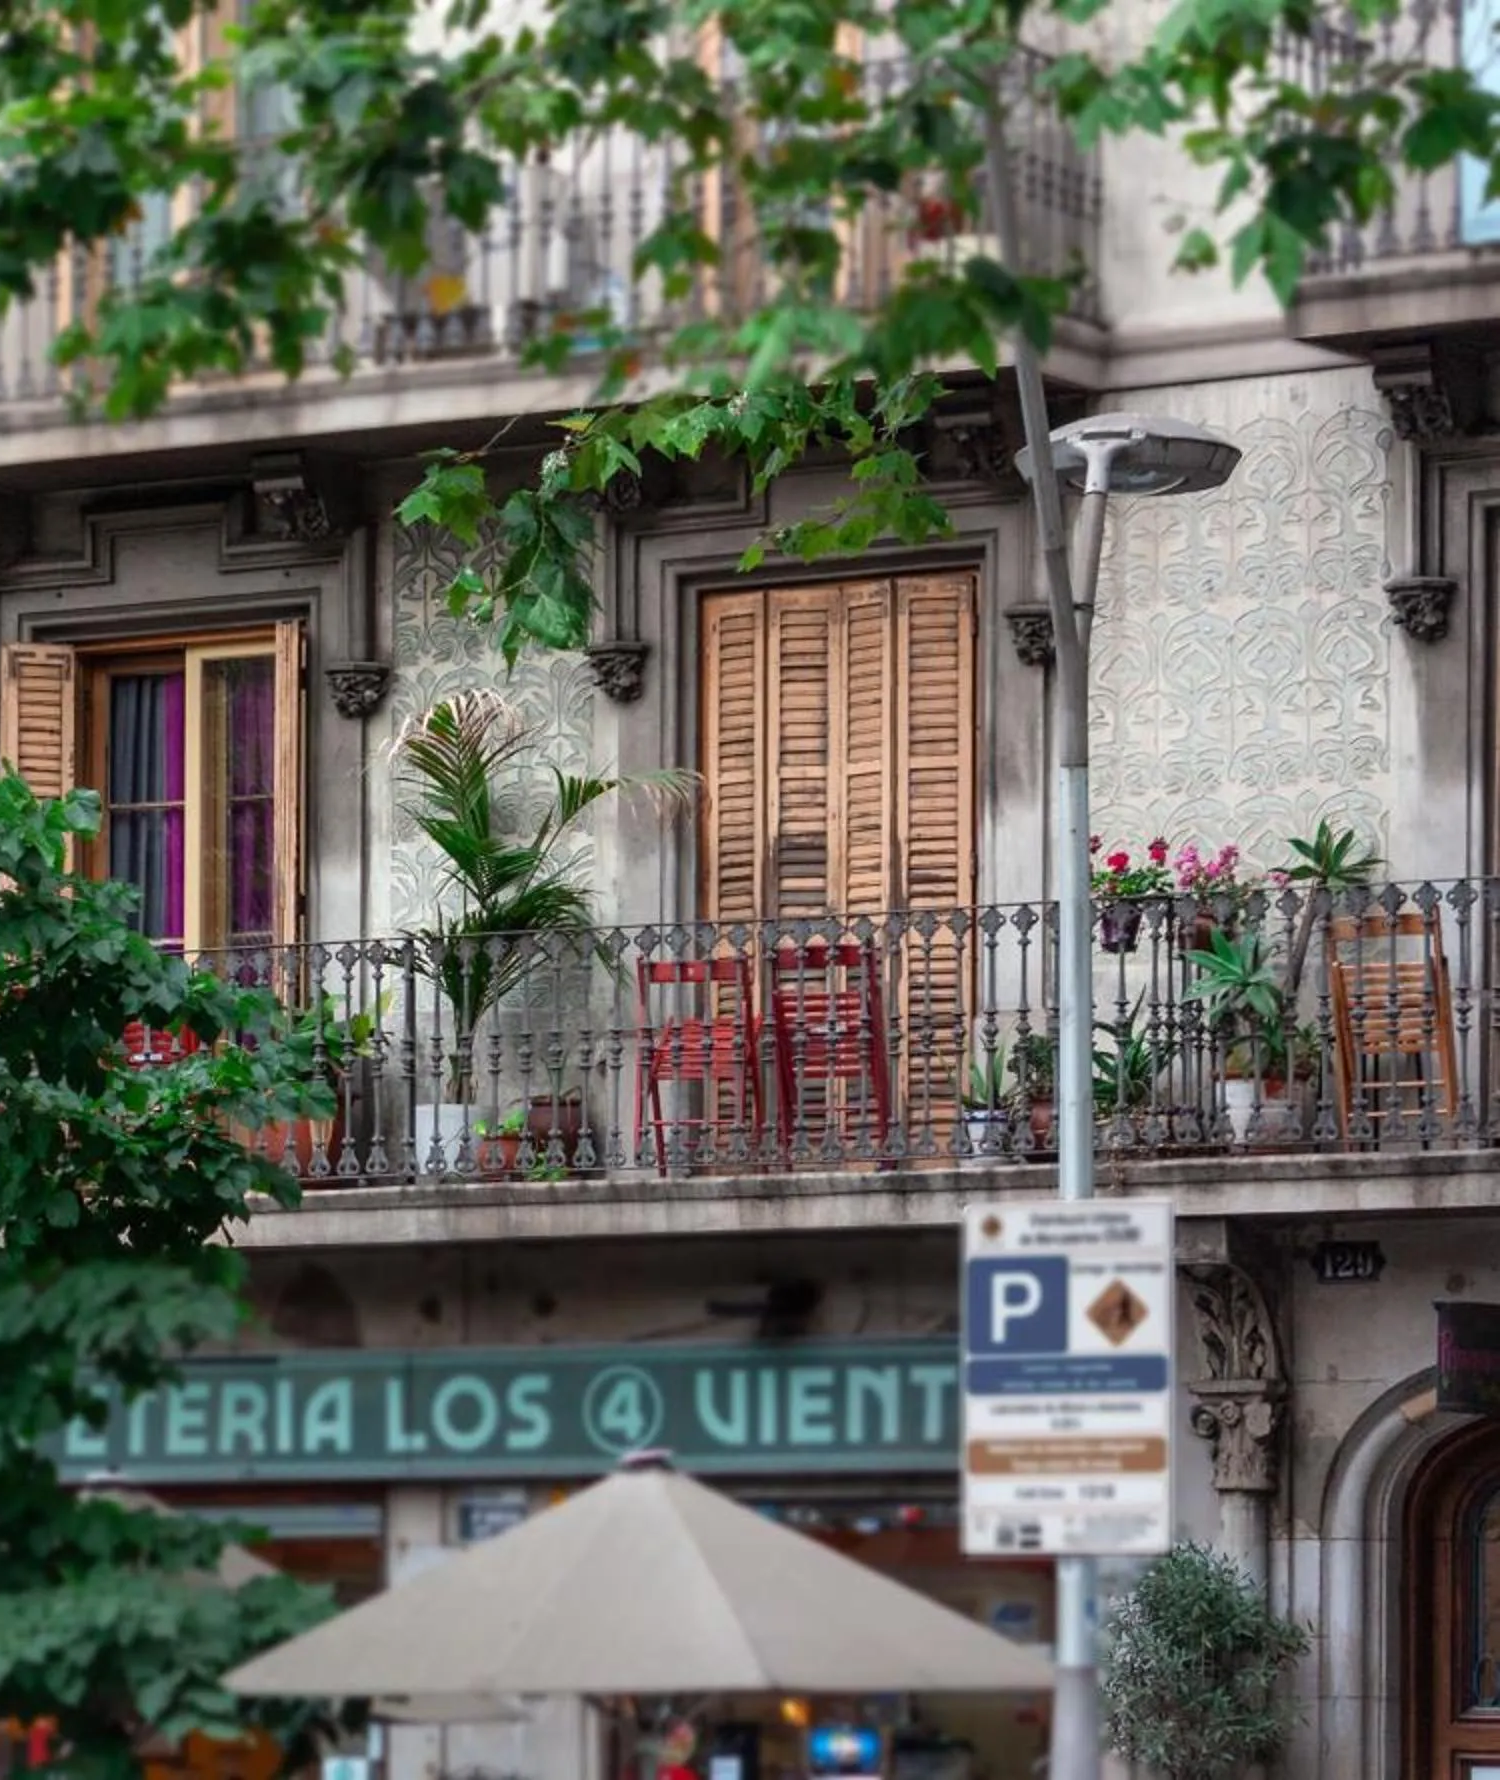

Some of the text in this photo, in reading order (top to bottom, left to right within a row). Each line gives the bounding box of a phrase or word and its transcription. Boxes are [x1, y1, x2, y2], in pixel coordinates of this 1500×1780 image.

[1324, 1249, 1374, 1278] 129
[990, 1271, 1043, 1344] P
[385, 1373, 550, 1452] LOS
[695, 1364, 956, 1446] VIENT
